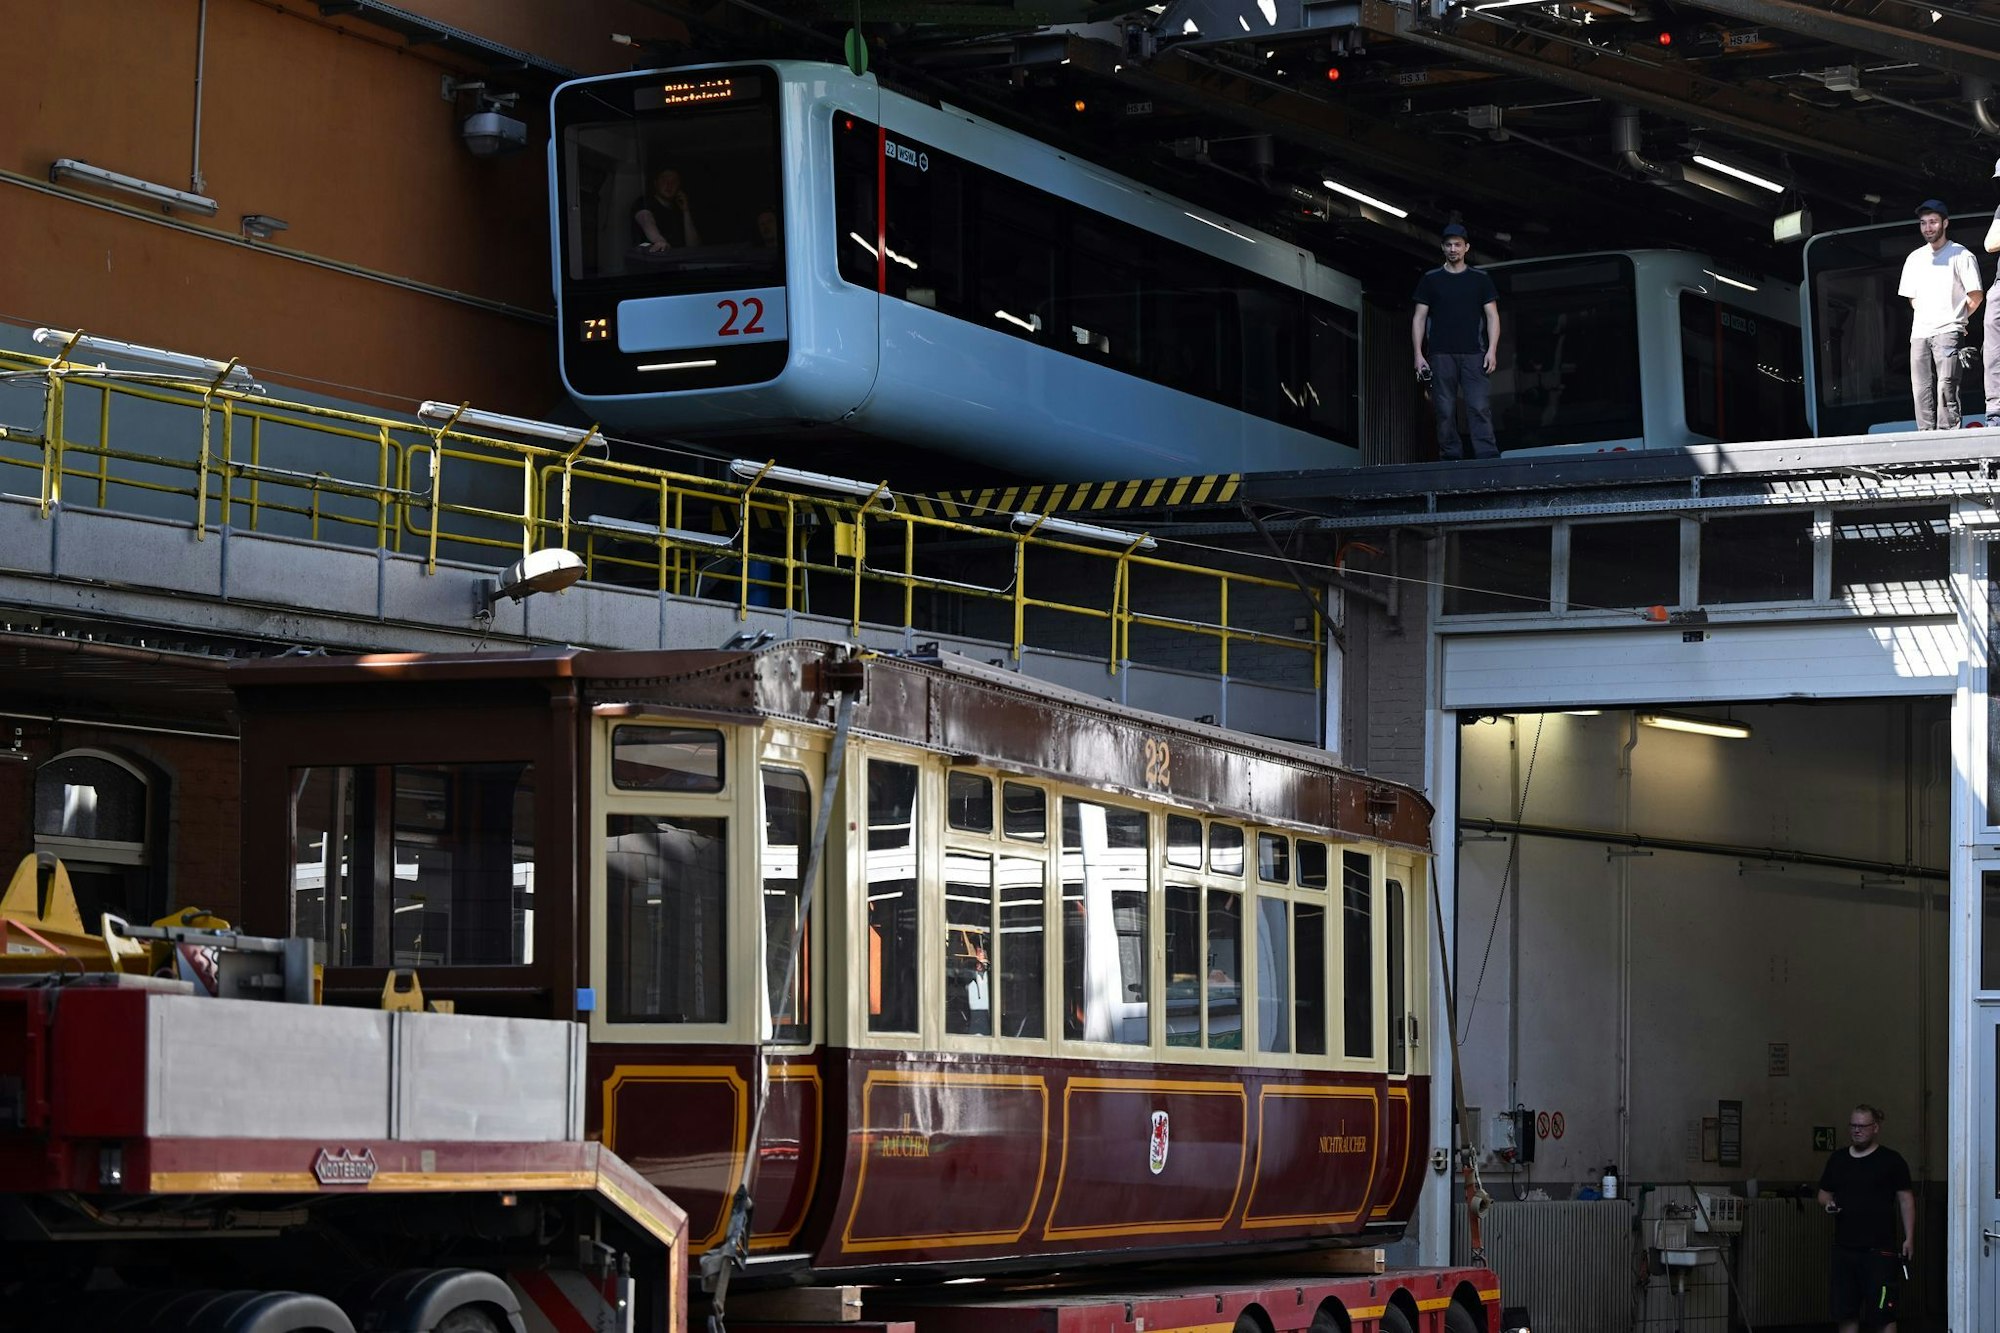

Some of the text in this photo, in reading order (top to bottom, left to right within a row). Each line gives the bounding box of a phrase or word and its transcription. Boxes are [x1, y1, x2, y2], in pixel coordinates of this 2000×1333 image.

[1731, 35, 1743, 46] HS
[1400, 73, 1413, 83] HS
[886, 142, 895, 156] 22
[717, 297, 765, 336] 22
[1145, 737, 1171, 787] 22
[882, 1135, 930, 1157] RAUCHER
[1318, 1136, 1367, 1153] NICHTRAUCHER
[320, 1162, 373, 1178] NOOTEBOOM
